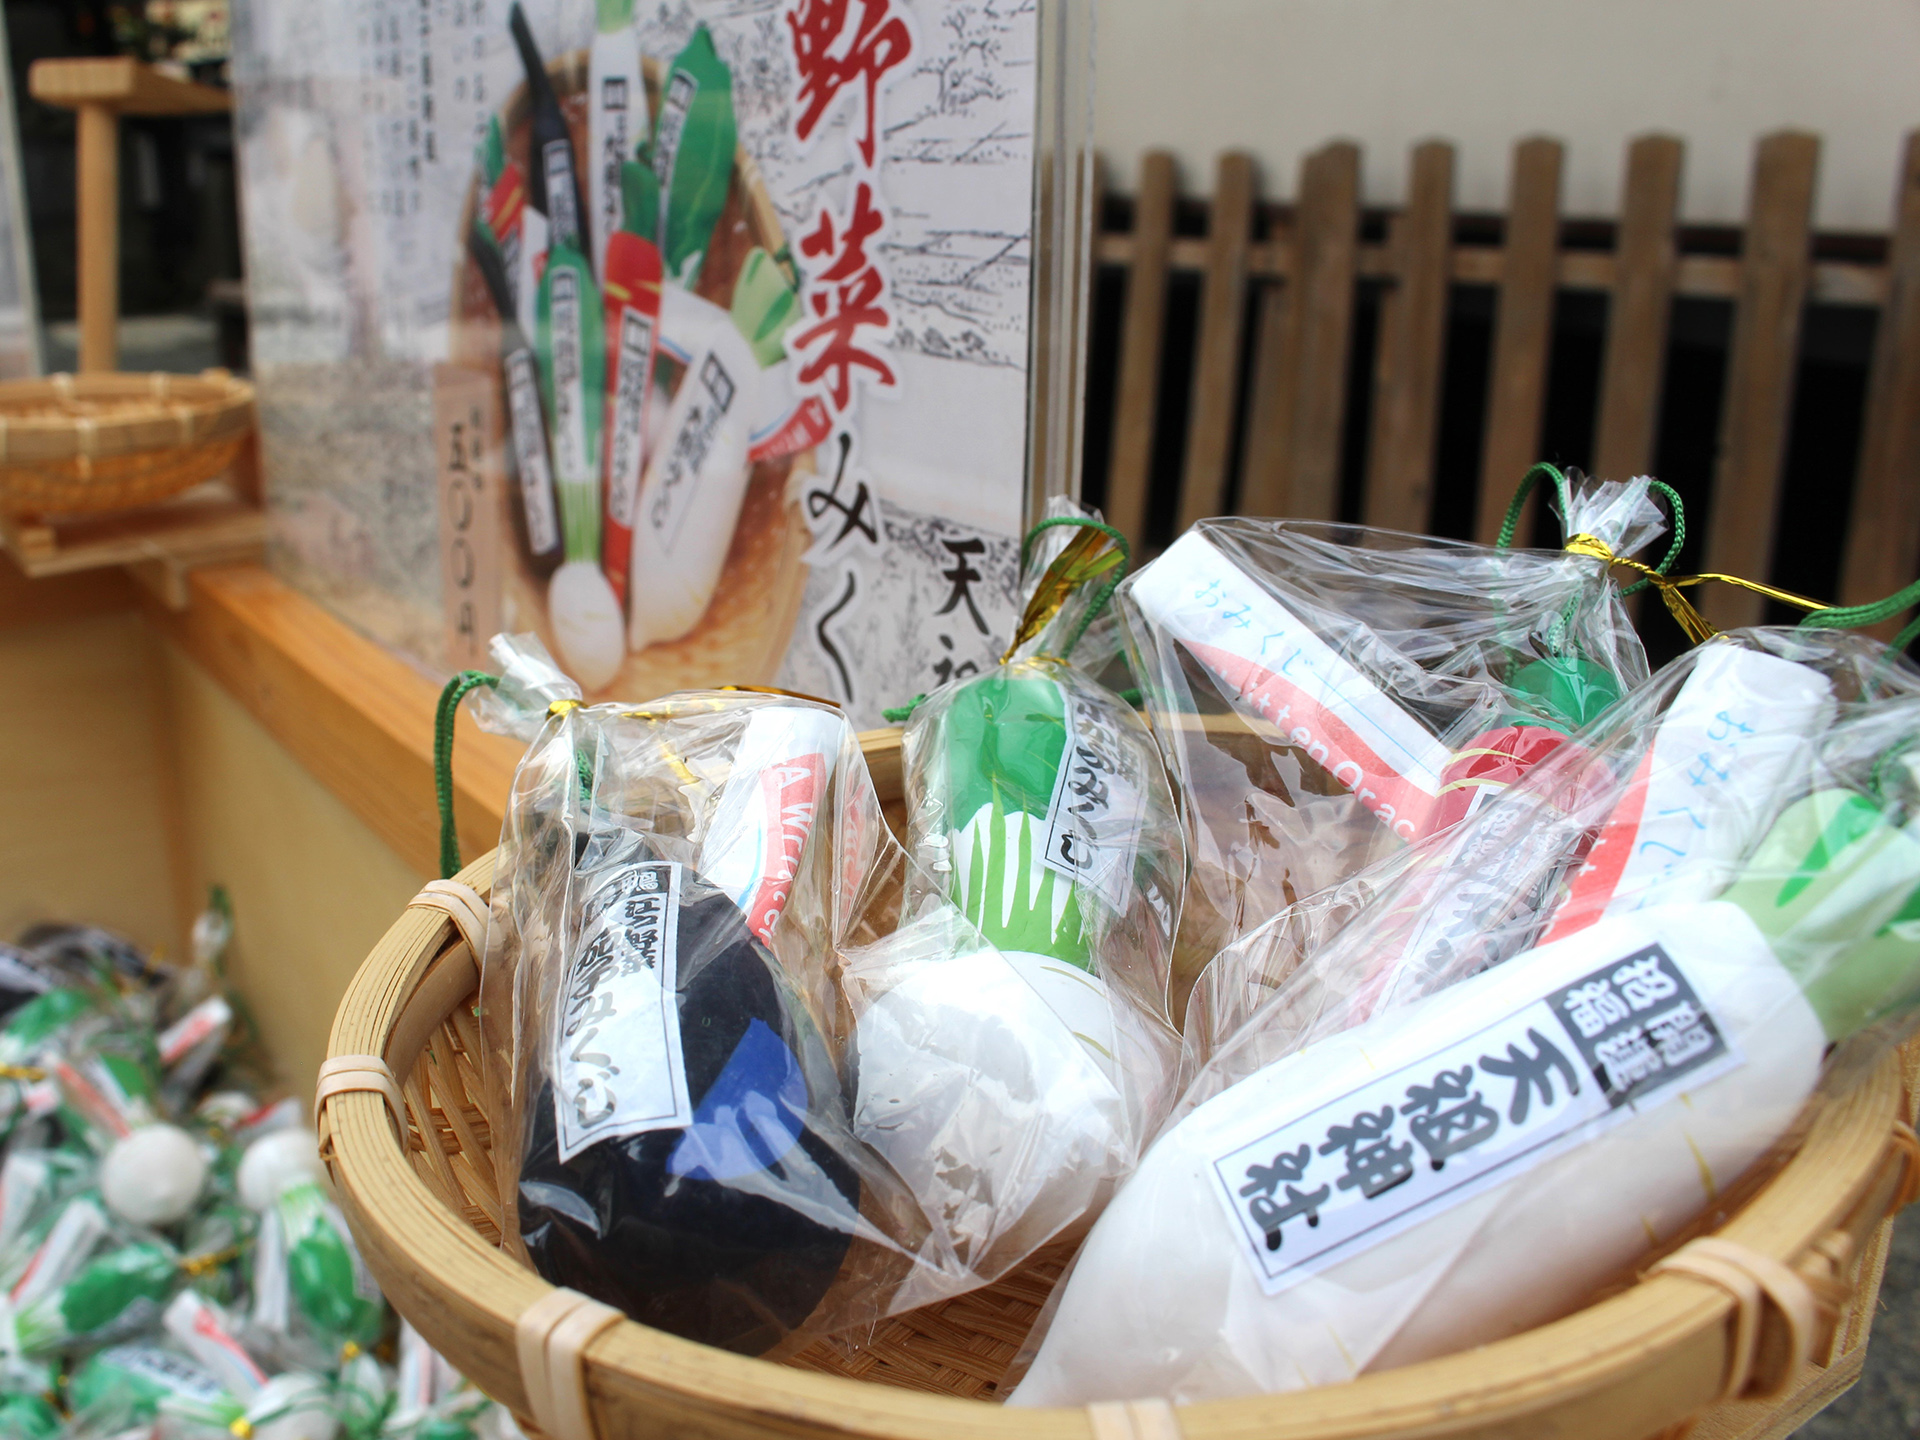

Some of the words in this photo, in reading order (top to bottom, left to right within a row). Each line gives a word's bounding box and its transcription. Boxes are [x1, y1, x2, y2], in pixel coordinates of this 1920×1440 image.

[1195, 579, 1314, 676] おみくじ
[778, 766, 812, 790] A
[1640, 710, 1756, 877] おみくじ
[621, 897, 661, 979] 江戸野菜
[1563, 954, 1679, 1039] 招福
[1594, 1001, 1715, 1092] 開運
[1238, 1026, 1583, 1252] 天祖神社
